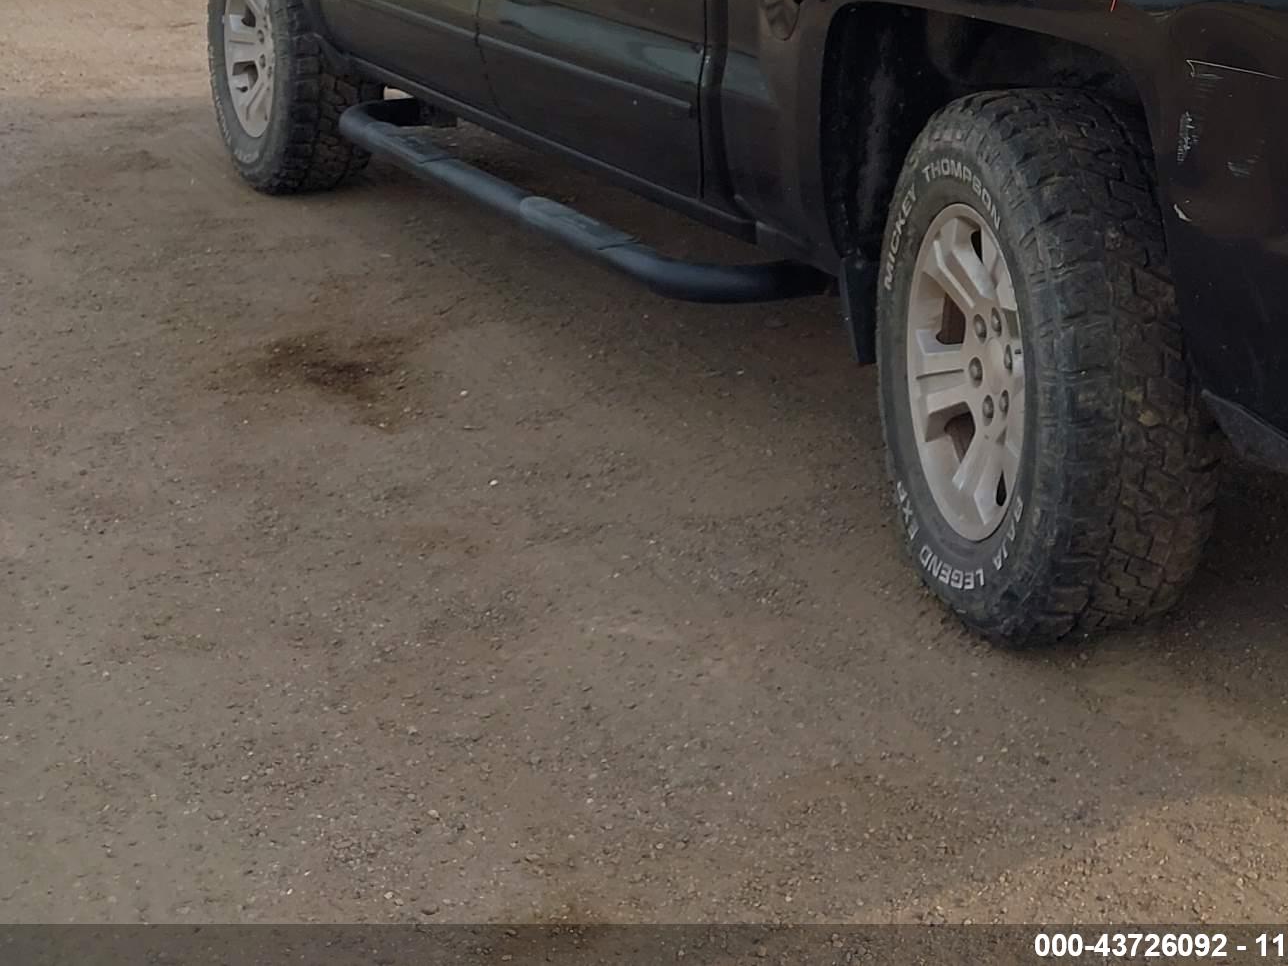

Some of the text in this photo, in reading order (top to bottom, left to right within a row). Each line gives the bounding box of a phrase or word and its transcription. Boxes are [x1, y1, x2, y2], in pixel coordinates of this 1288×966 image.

[883, 158, 1001, 291] MICKEY THOMPSON
[918, 544, 985, 590] LEGEND
[992, 494, 1024, 571] BAJA
